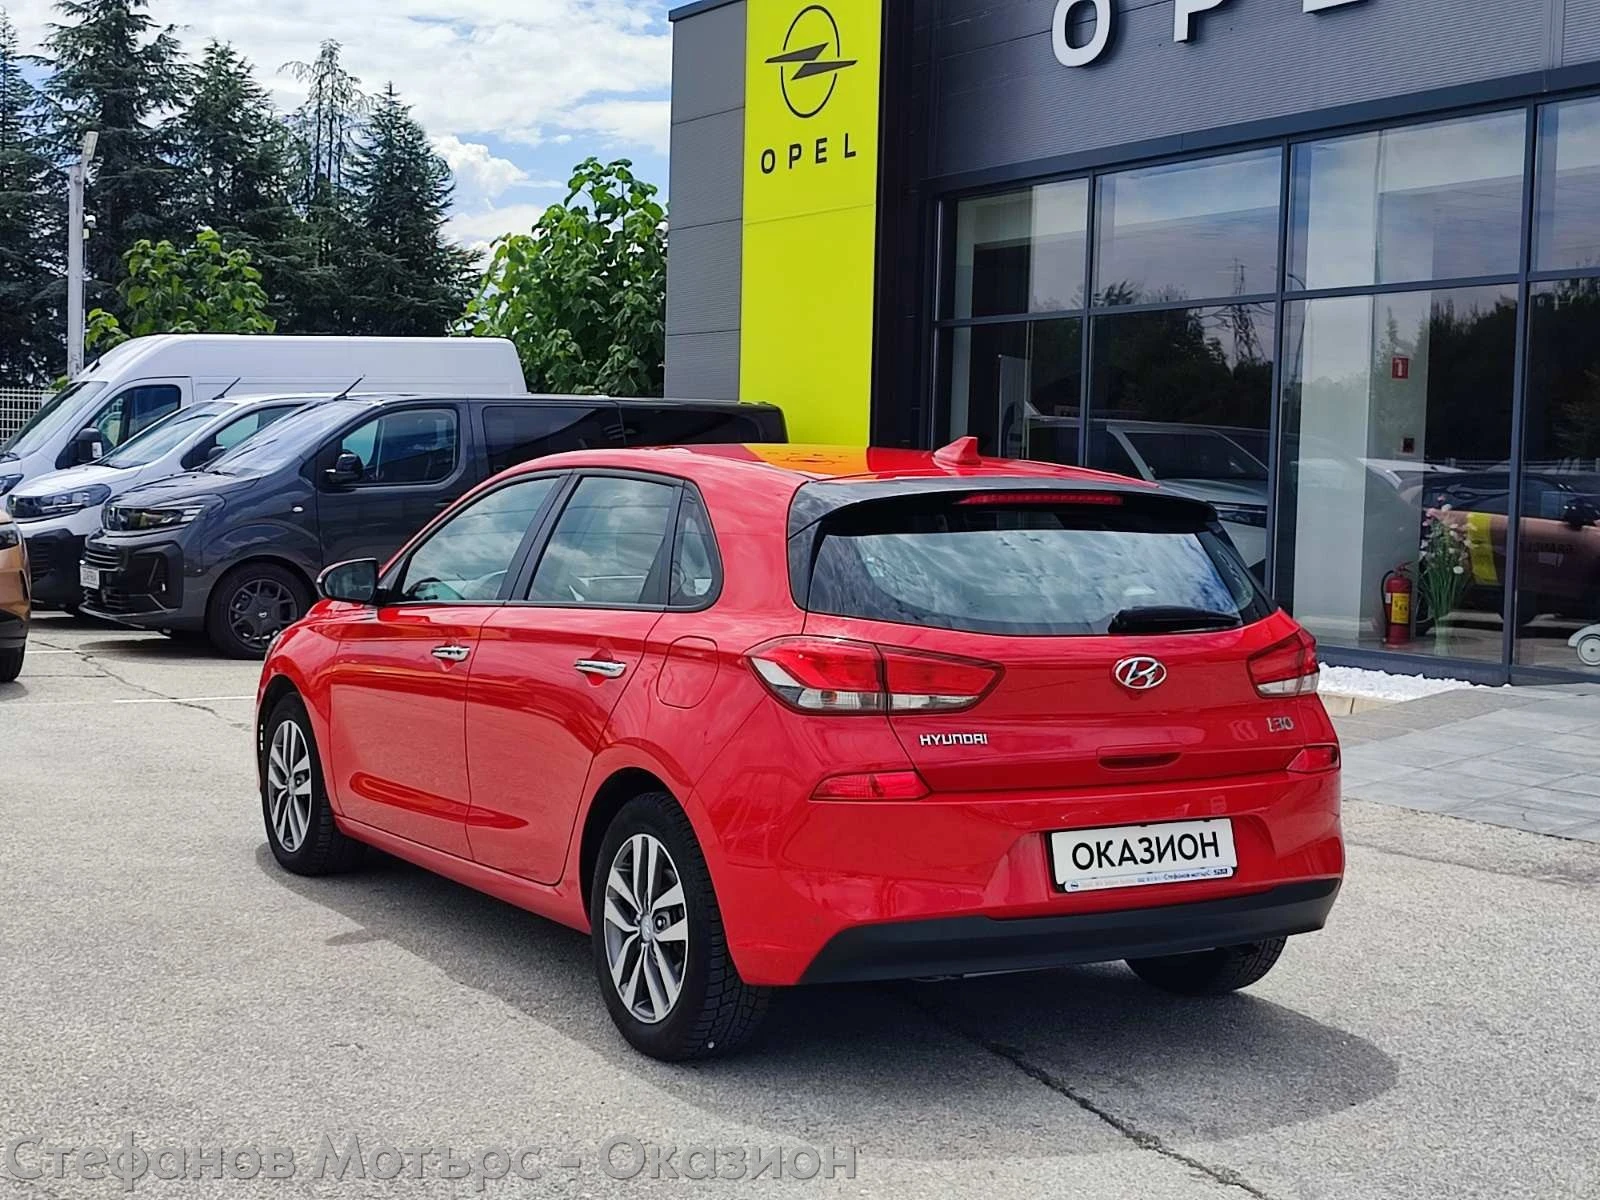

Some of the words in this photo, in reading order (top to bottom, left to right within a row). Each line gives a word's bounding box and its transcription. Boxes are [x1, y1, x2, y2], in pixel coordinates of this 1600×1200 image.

[760, 132, 857, 175] OPEL
[919, 733, 989, 746] HYUNDAI
[1071, 831, 1220, 871] ОКАЗИОН
